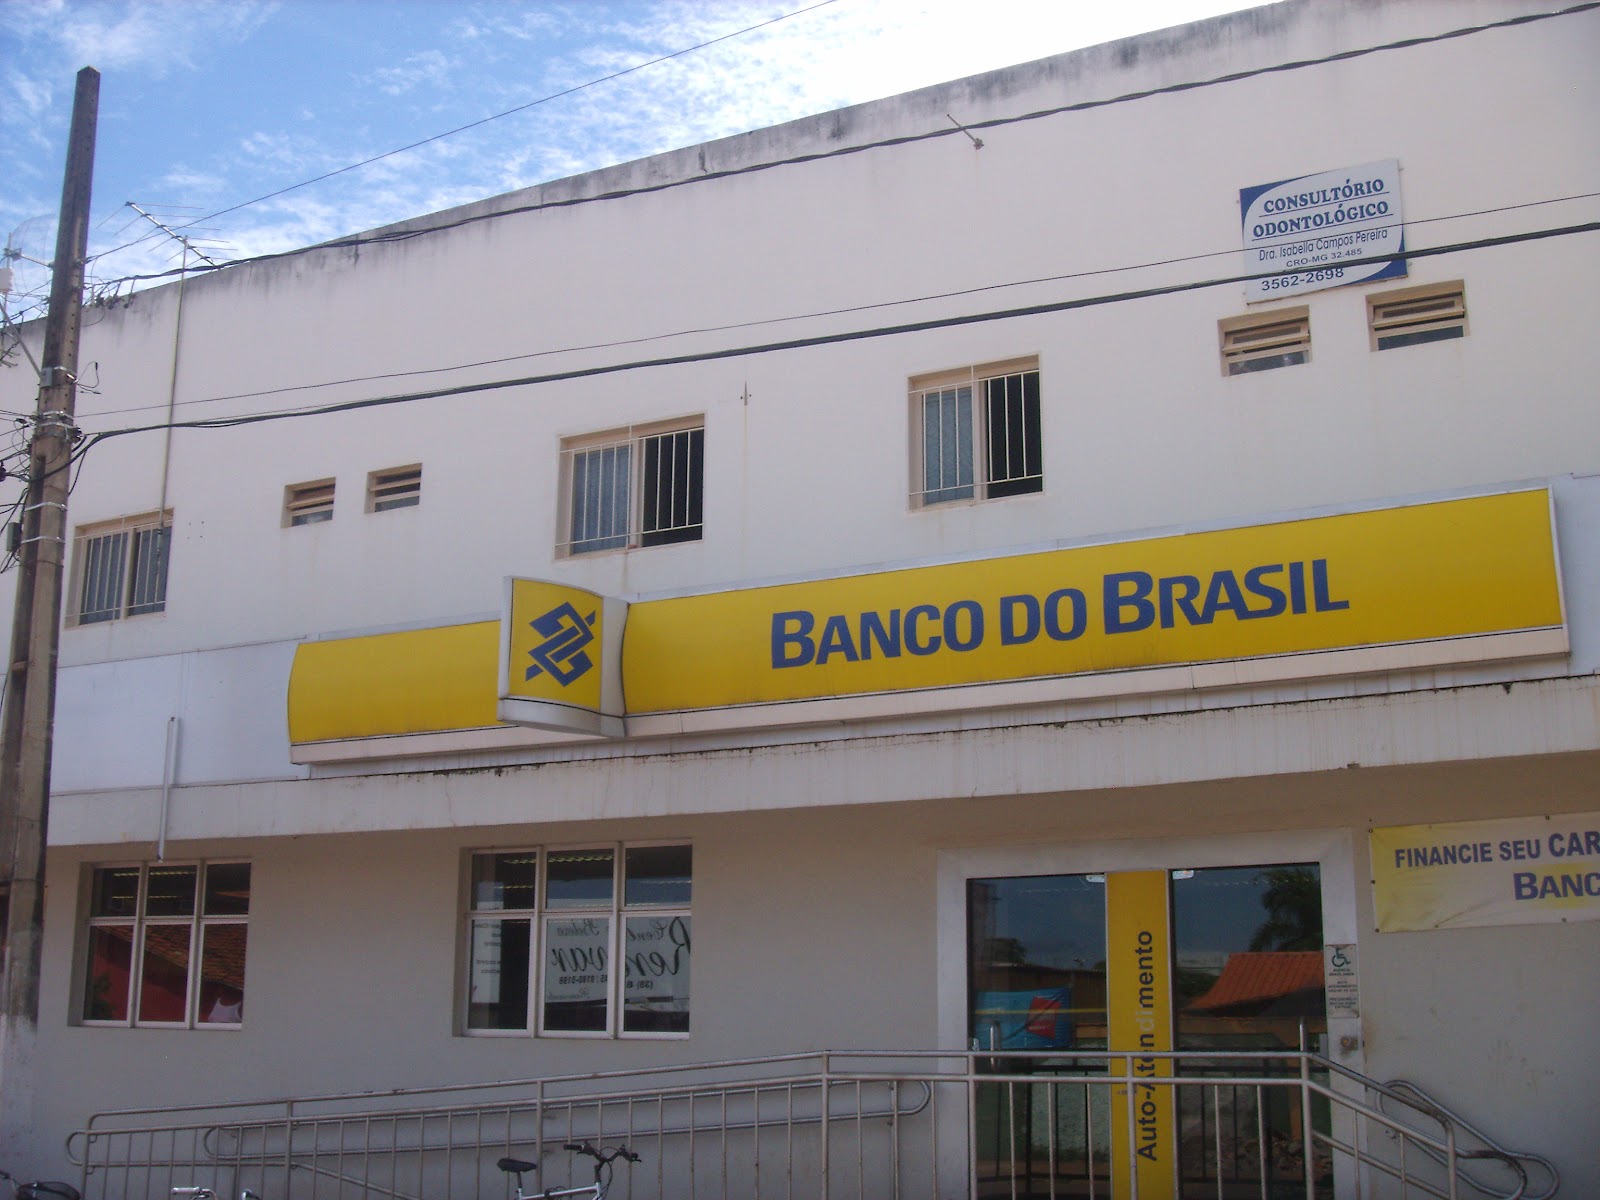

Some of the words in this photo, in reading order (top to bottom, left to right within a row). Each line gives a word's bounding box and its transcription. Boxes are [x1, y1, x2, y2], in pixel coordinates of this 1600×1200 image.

[1263, 178, 1384, 213] CONSULTÓRIO
[1252, 201, 1389, 238] ODONTOLÓGICO
[1259, 249, 1278, 261] Dra.
[1279, 241, 1314, 258] Isabella
[1315, 233, 1354, 250] Campos
[1355, 228, 1388, 243] Pereira
[1286, 254, 1328, 268] CRO-MG
[1331, 247, 1363, 260] 32.485
[1261, 267, 1345, 292] 3562-2698
[771, 600, 984, 669] BANCO
[1000, 588, 1087, 646] DO
[1103, 558, 1350, 635] BRASIL
[1395, 842, 1493, 868] FINANCIE
[1499, 839, 1541, 861] SEU
[1548, 831, 1600, 857] CAR
[1513, 872, 1600, 901] BANC
